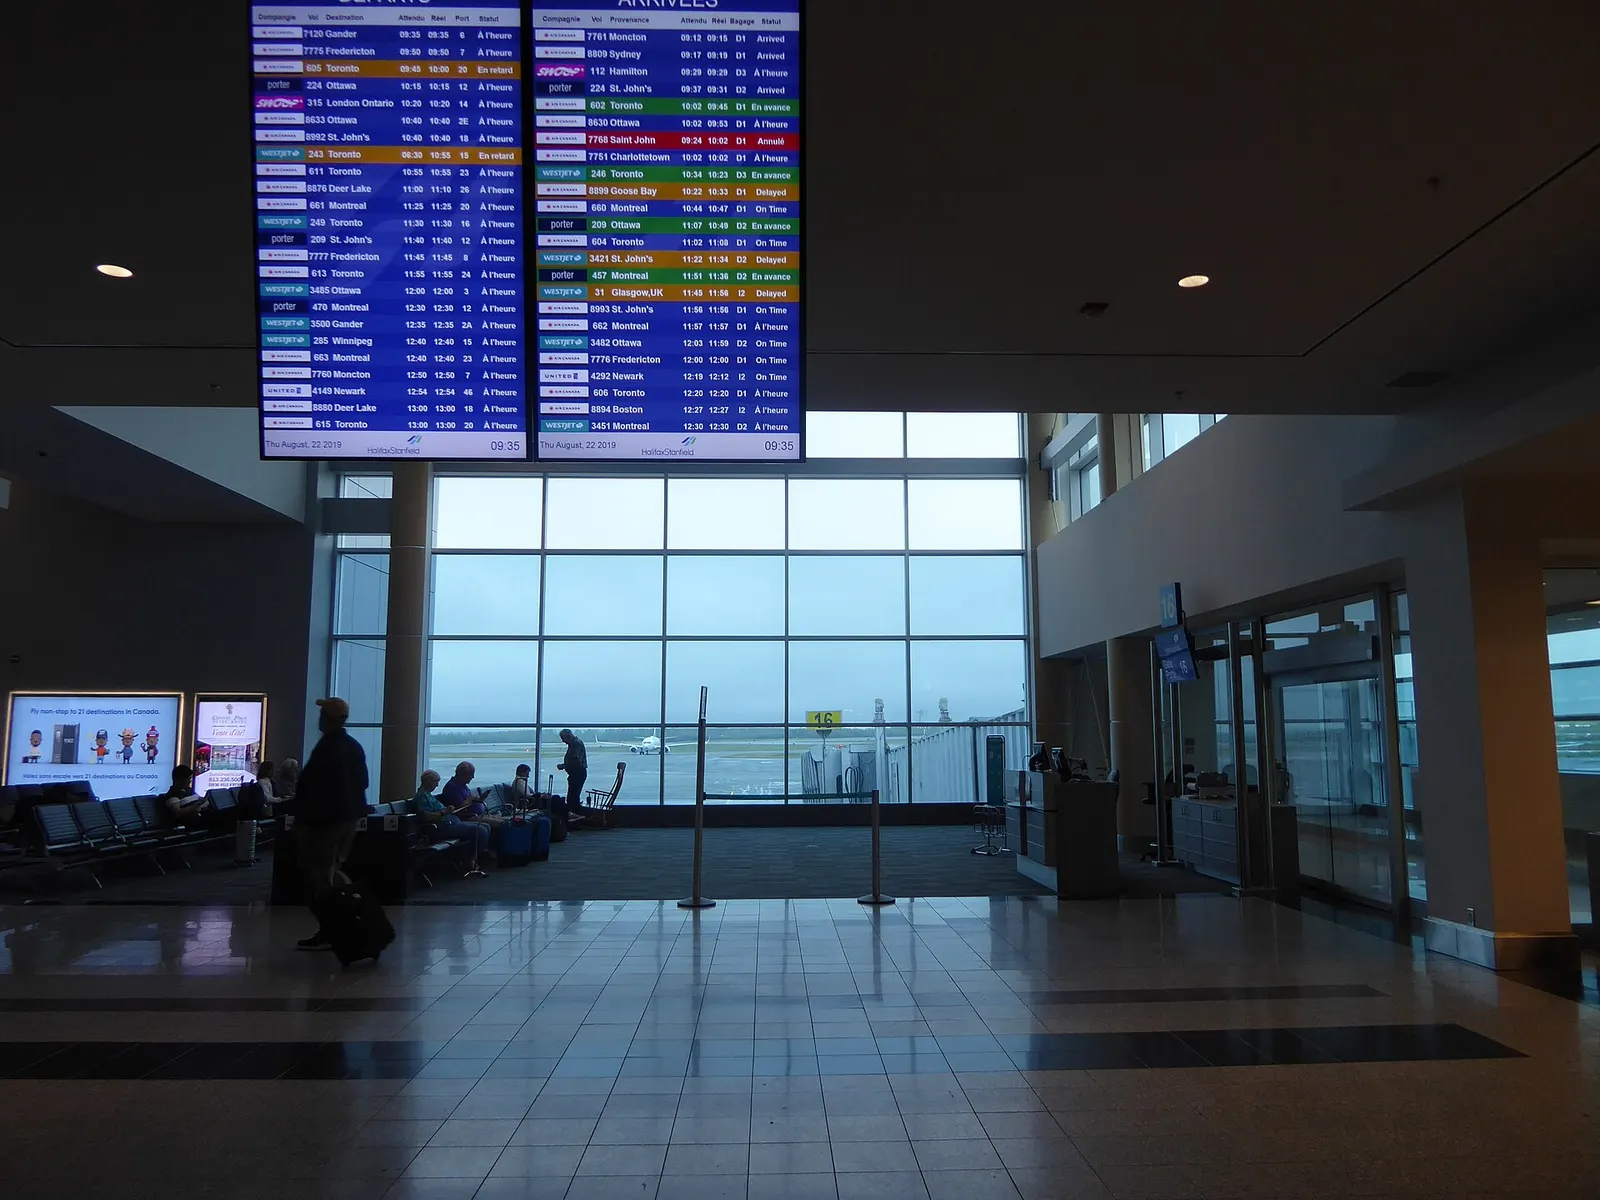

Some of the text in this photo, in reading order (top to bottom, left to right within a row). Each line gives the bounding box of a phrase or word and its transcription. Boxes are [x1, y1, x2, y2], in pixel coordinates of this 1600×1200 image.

[303, 30, 357, 39] 7120 Gander
[587, 33, 647, 42] 7761 Moncton
[304, 47, 375, 56] 7775 Fredericton
[609, 50, 641, 61] Sydney
[326, 64, 360, 73] Toronto
[590, 67, 648, 76] 112 Hamilton
[307, 82, 357, 90] 224 Ottawa
[590, 84, 652, 93] 224 St. John's
[307, 99, 394, 108] 315 London Ontario
[590, 102, 643, 110] 602 Toronto
[327, 116, 357, 125] Ottawa
[588, 119, 640, 128] 8630 Ottawa
[327, 133, 370, 142] St. John's
[588, 136, 656, 145] 7768 Saint John
[308, 150, 362, 159] 243 Toronto
[588, 152, 670, 161] 7751 Charlottetown
[309, 167, 362, 176] 611 Toronto
[591, 170, 643, 178] 246 Toronto
[329, 184, 349, 193] Deer
[351, 184, 371, 193] Lake
[610, 187, 638, 196] Goose
[640, 187, 657, 198] Bay
[309, 202, 366, 210] 661 Montreal
[591, 204, 648, 213] 660 Montreal
[310, 218, 363, 227] 249 Toronto
[592, 221, 641, 230] 209 Ottawa
[310, 236, 372, 244] 209 St. John's
[592, 238, 644, 246] 604 Toronto
[309, 252, 380, 261] 7777 Fredericton
[589, 254, 653, 263] 3421 St. John's
[311, 270, 364, 278] 613 Toronto
[592, 271, 649, 280] 457 Montreal
[331, 286, 361, 295] Ottawa
[594, 288, 604, 297] 31
[312, 303, 369, 312] 470 Montreal
[590, 305, 654, 314] 8993 St. John's
[310, 320, 363, 329] 3500 Gander
[592, 322, 649, 330] 662 Montreal
[313, 337, 373, 348] 285 Winnipeg
[590, 339, 642, 348] 3482 Ottawa
[333, 354, 370, 362] Montreal
[591, 356, 661, 364] 7776 Fredericton
[312, 370, 370, 379] 7760 Moncton
[591, 372, 644, 381] 4292 Newark
[312, 387, 366, 396] 4149 Newark
[593, 389, 646, 398] 606 Toronto
[334, 404, 354, 412] Deer
[356, 404, 377, 412] Lake
[591, 405, 643, 414] 8894 Boston
[316, 420, 368, 429] 615 Toronto
[591, 422, 650, 431] 3451 Montreal
[491, 442, 520, 450] 09:35
[765, 441, 794, 450] 09:35
[814, 712, 833, 728] 16
